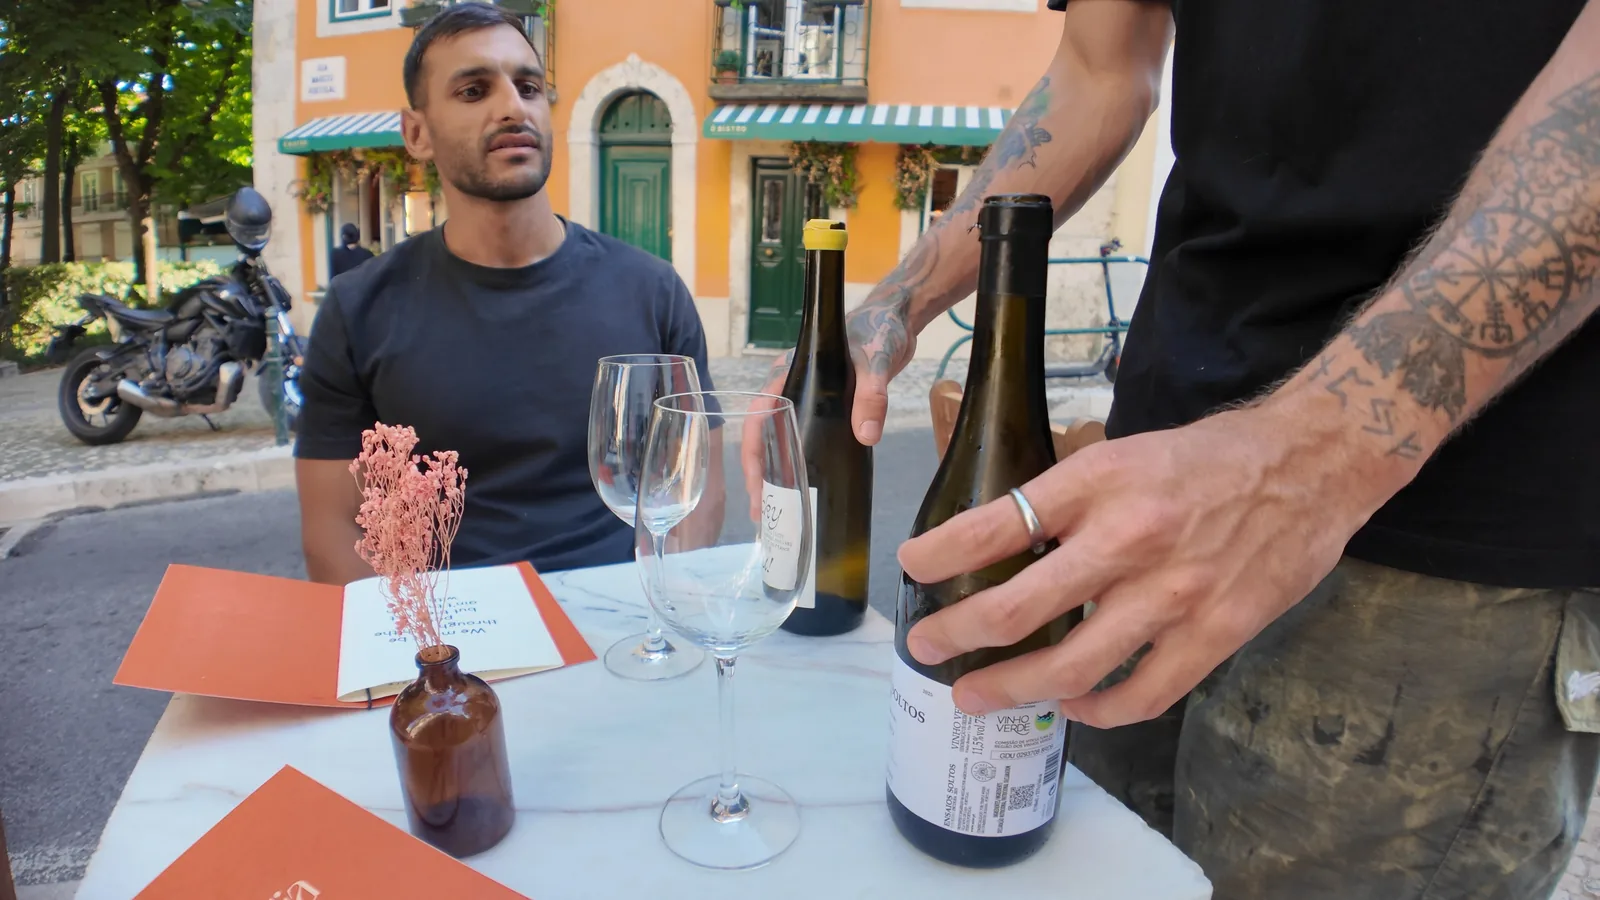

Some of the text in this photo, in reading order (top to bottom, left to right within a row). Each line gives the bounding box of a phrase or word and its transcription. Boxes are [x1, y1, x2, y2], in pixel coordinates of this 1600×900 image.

[438, 619, 498, 630] through
[997, 714, 1030, 724] VINHO
[951, 721, 962, 750] VINHO
[996, 722, 1031, 736] VERDE
[999, 752, 1015, 760] GDU
[946, 763, 957, 794] SOLTOS
[943, 794, 954, 828] ENSAIOS
